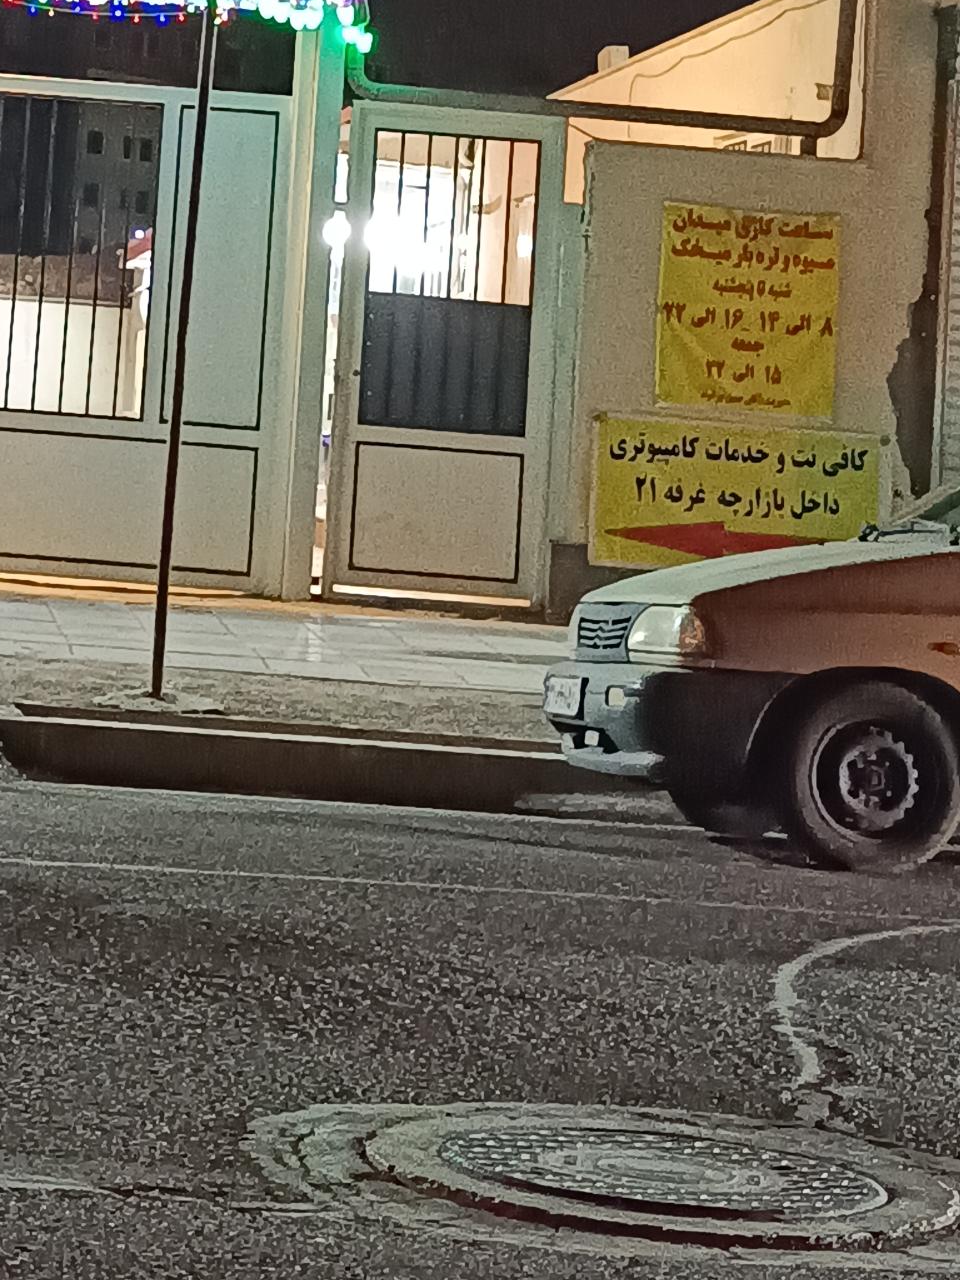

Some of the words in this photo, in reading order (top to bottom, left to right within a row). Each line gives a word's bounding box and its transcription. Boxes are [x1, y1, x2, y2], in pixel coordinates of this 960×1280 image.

[672, 208, 731, 235] میدان
[780, 254, 792, 273] و
[792, 254, 835, 274] میوه
[691, 306, 716, 328] الی
[785, 313, 812, 336] الی
[819, 316, 833, 337] ۸
[732, 363, 755, 383] الی
[610, 432, 700, 466] کامپیوتری
[705, 438, 769, 464] خدمات
[791, 445, 816, 469] نت
[822, 443, 869, 477] کافی
[776, 451, 785, 474] و
[635, 476, 656, 504] ۲۱
[664, 477, 706, 512] غرفه
[717, 487, 785, 519] بازارچه
[790, 489, 840, 520] داخل
